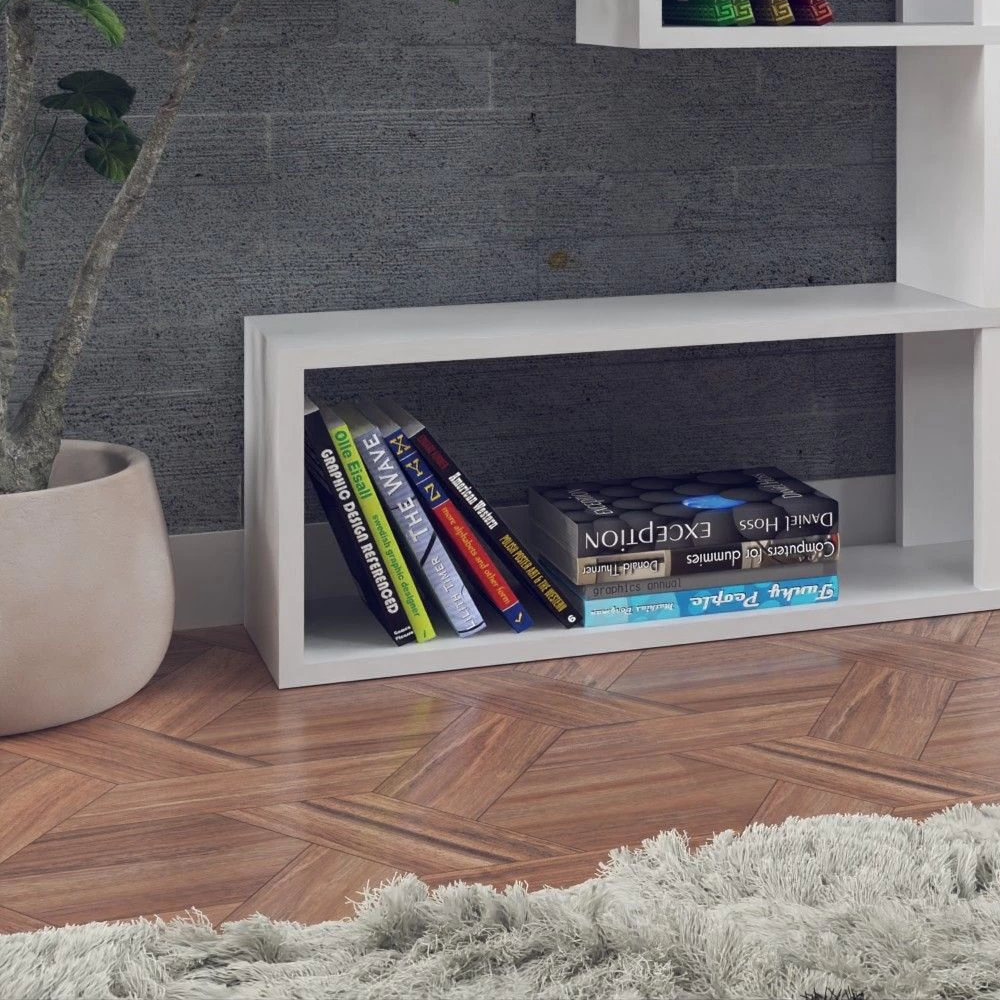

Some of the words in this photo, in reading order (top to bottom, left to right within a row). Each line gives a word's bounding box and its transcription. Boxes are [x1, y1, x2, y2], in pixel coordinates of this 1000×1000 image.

[389, 434, 411, 456] X
[362, 433, 403, 497] WAVE
[405, 458, 424, 477] Y
[424, 482, 442, 502] Z
[448, 471, 478, 506] American
[472, 499, 499, 530] Western
[397, 496, 429, 543] THE
[320, 448, 352, 501] GRAPHIC
[342, 501, 369, 543] DESIGN
[360, 542, 399, 615] REFERENCED
[686, 547, 742, 567] dummies
[745, 548, 762, 564] for
[767, 540, 836, 559] Computers
[372, 514, 391, 550] swedish
[385, 547, 405, 581] graphic
[401, 581, 421, 617] designer
[475, 550, 487, 567] and
[484, 565, 500, 588] other
[512, 549, 533, 571] POSTER
[525, 565, 541, 580] ART
[537, 578, 551, 592] THE
[581, 561, 620, 577] Thurner
[623, 558, 659, 574] Donald
[689, 588, 760, 609] People
[767, 581, 835, 601] Funky
